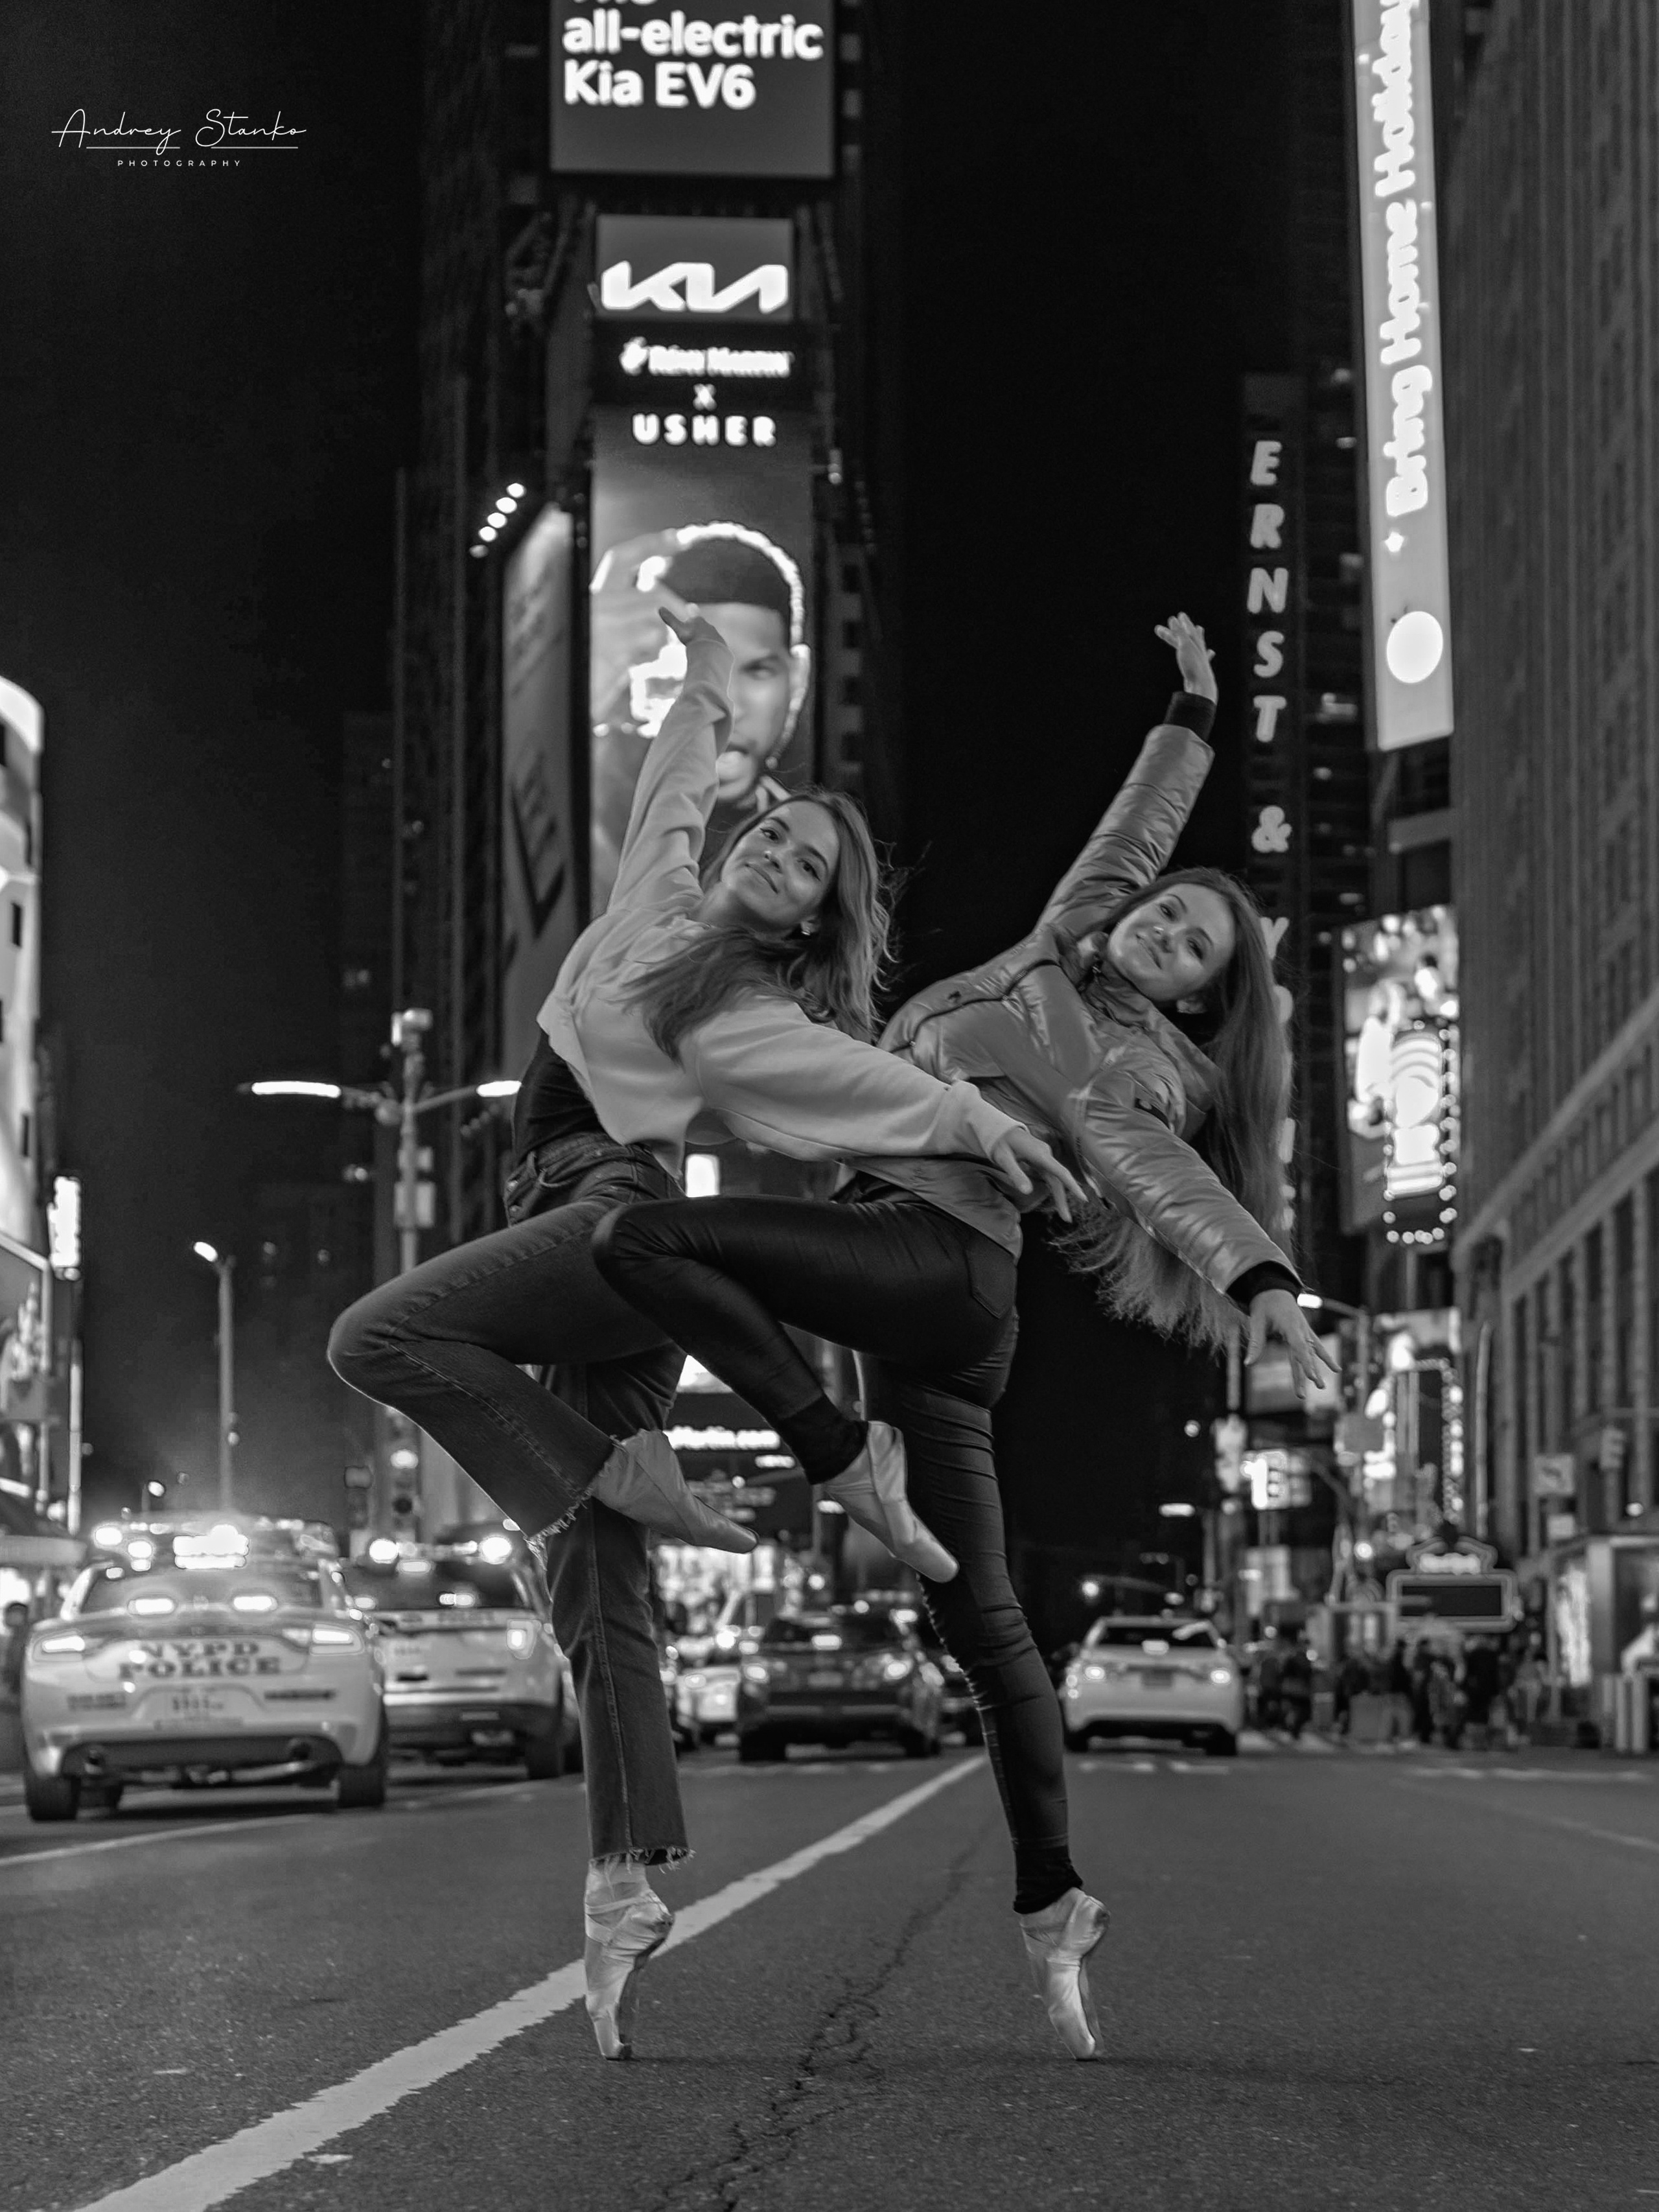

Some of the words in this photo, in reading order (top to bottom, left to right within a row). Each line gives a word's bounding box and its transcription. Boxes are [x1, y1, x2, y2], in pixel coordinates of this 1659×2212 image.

[562, 8, 824, 61] all-electric
[564, 60, 643, 106] Kia
[655, 62, 756, 110] EV6
[1380, 199, 1421, 365] Home
[631, 413, 776, 447] USHER
[1383, 364, 1433, 517] Bring
[1247, 441, 1288, 742] ERNST
[1251, 806, 1292, 853] &
[119, 1657, 281, 1681] POLICE
[140, 1642, 259, 1658] NYPD
